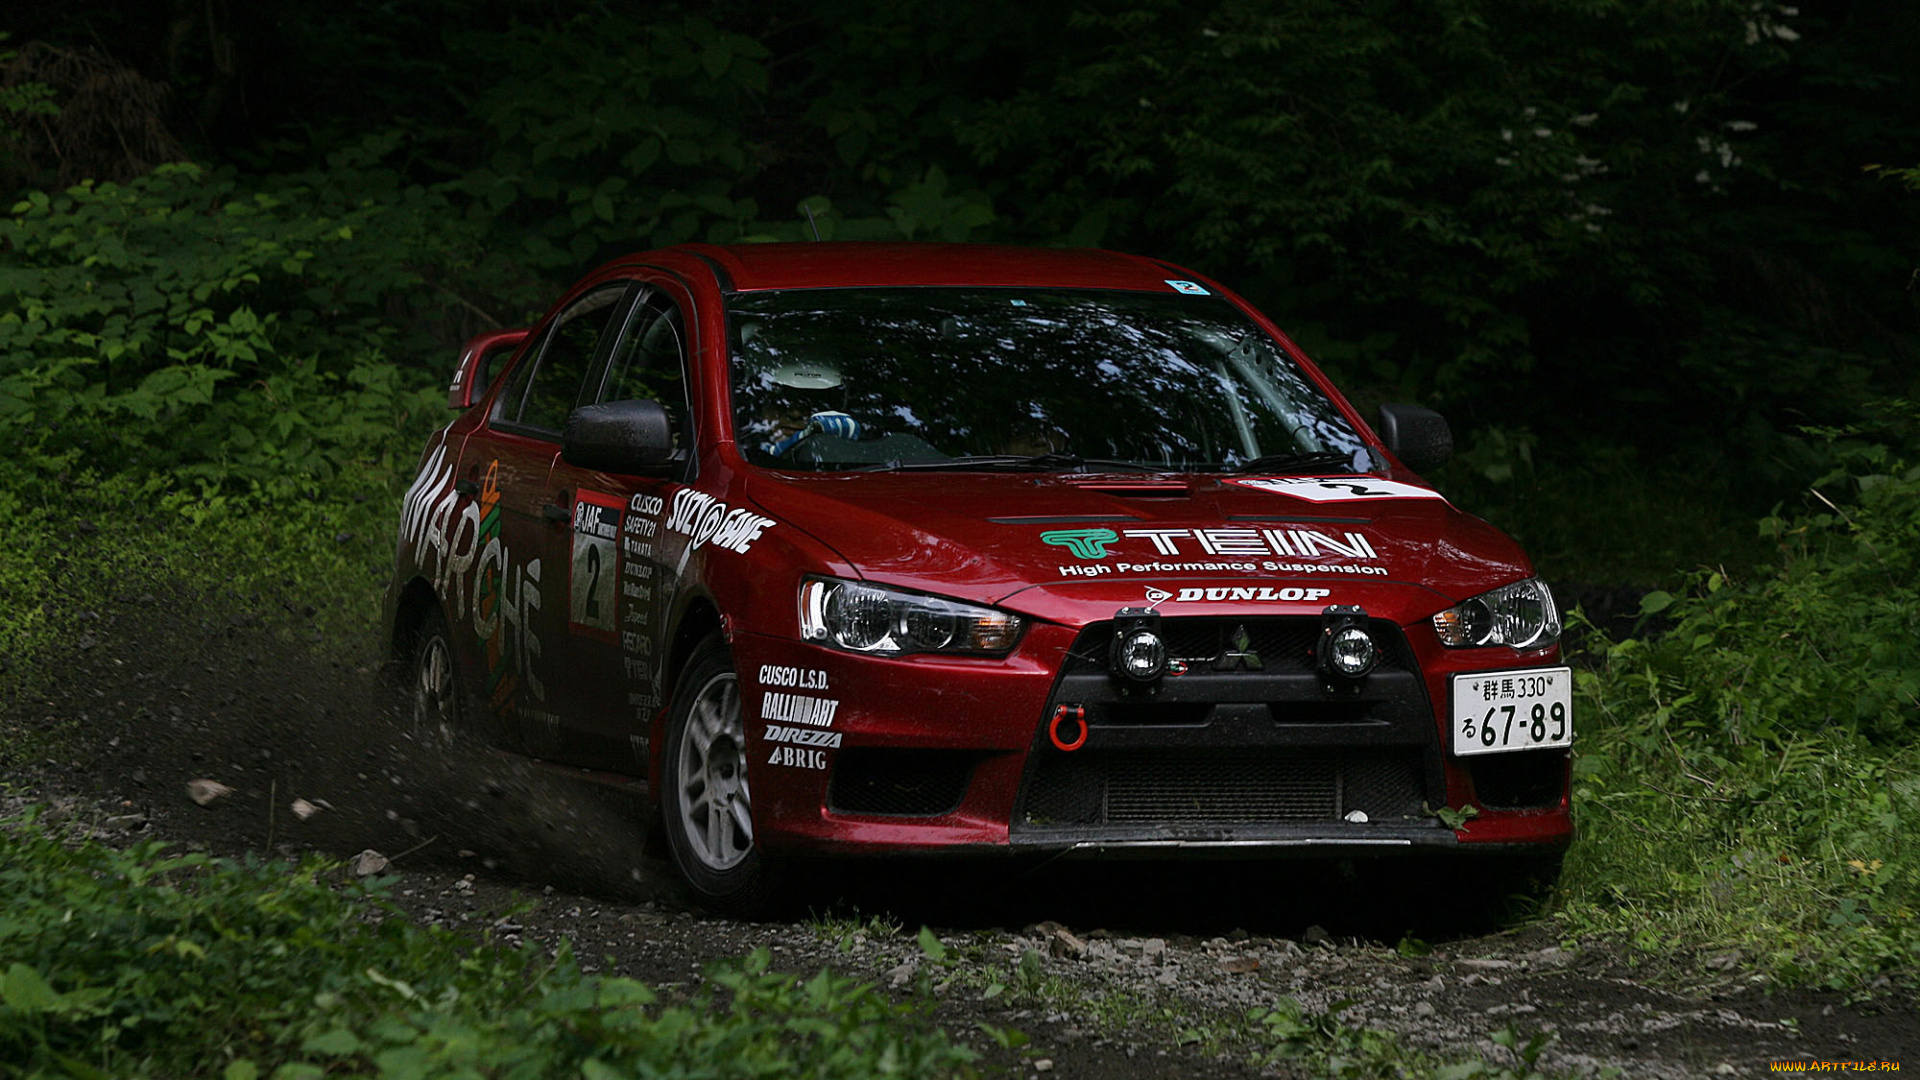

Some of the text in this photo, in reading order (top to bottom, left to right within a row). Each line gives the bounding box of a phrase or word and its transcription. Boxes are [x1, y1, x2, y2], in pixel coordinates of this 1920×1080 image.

[1319, 483, 1394, 496] 2
[630, 493, 663, 516] CUSCO
[582, 504, 603, 534] JAF
[631, 540, 652, 559] TAKATA
[1122, 528, 1378, 559] TEIN
[586, 543, 600, 619] 2
[624, 561, 653, 580] DUNLOP
[1058, 561, 1388, 577] High Performance Suspension
[1175, 587, 1330, 601] DUNLOP
[759, 664, 829, 690] CUSCO L.S.D.
[1483, 676, 1546, 701] 群馬 330
[760, 691, 839, 727] RALLIART
[763, 724, 842, 749] DIREZZA
[1461, 702, 1566, 747] る 67-89
[767, 746, 827, 770] ABRIG
